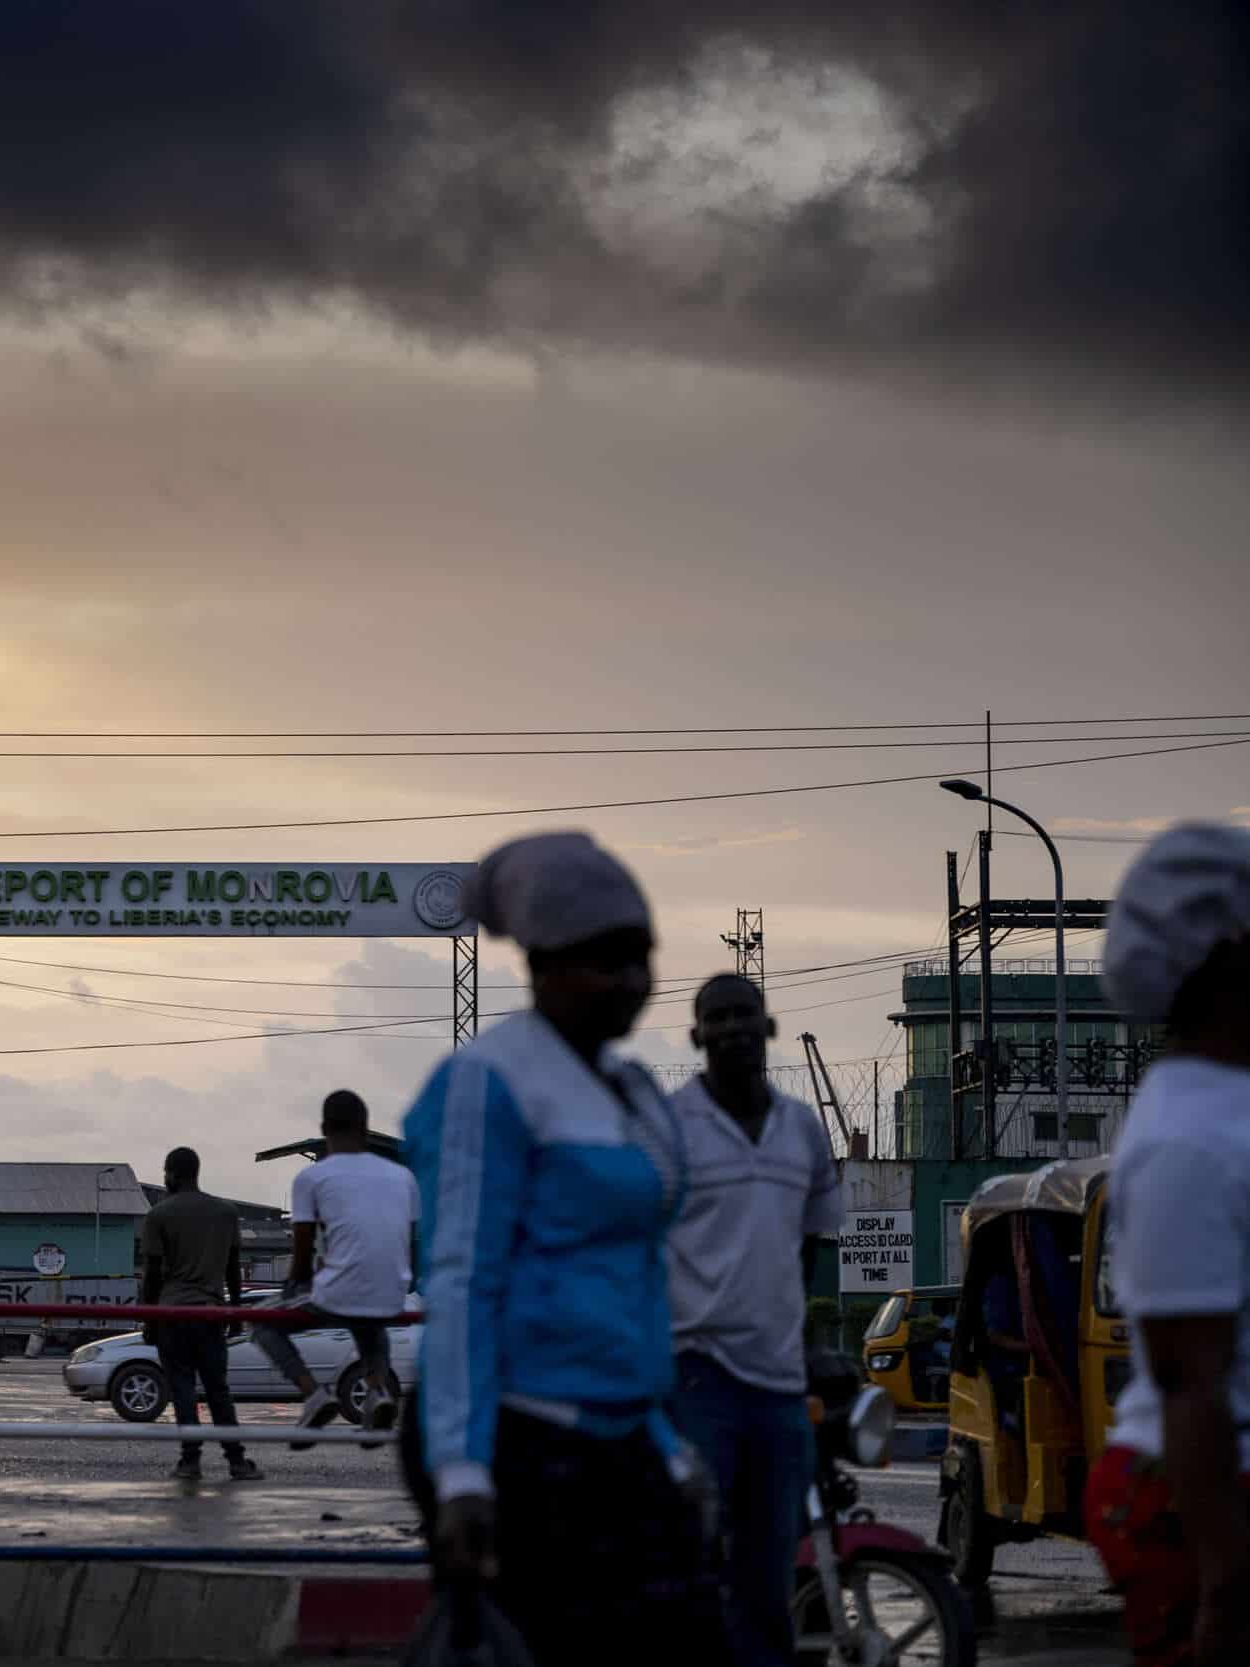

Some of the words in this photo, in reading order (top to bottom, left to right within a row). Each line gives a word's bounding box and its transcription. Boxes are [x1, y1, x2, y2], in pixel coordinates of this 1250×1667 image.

[120, 869, 174, 903] OF
[186, 870, 398, 903] MONROVIA
[69, 909, 101, 927] TO
[109, 909, 223, 927] LIBERIA'S
[230, 909, 352, 927] ECONOMY
[856, 1217, 895, 1231] DISPLAY
[838, 1233, 877, 1248] ACCESS
[888, 1233, 913, 1247] CARD
[842, 1251, 852, 1265] IN
[853, 1251, 879, 1264] PORT
[880, 1251, 892, 1264] AT
[893, 1250, 911, 1263] ALL
[861, 1268, 888, 1281] TIME
